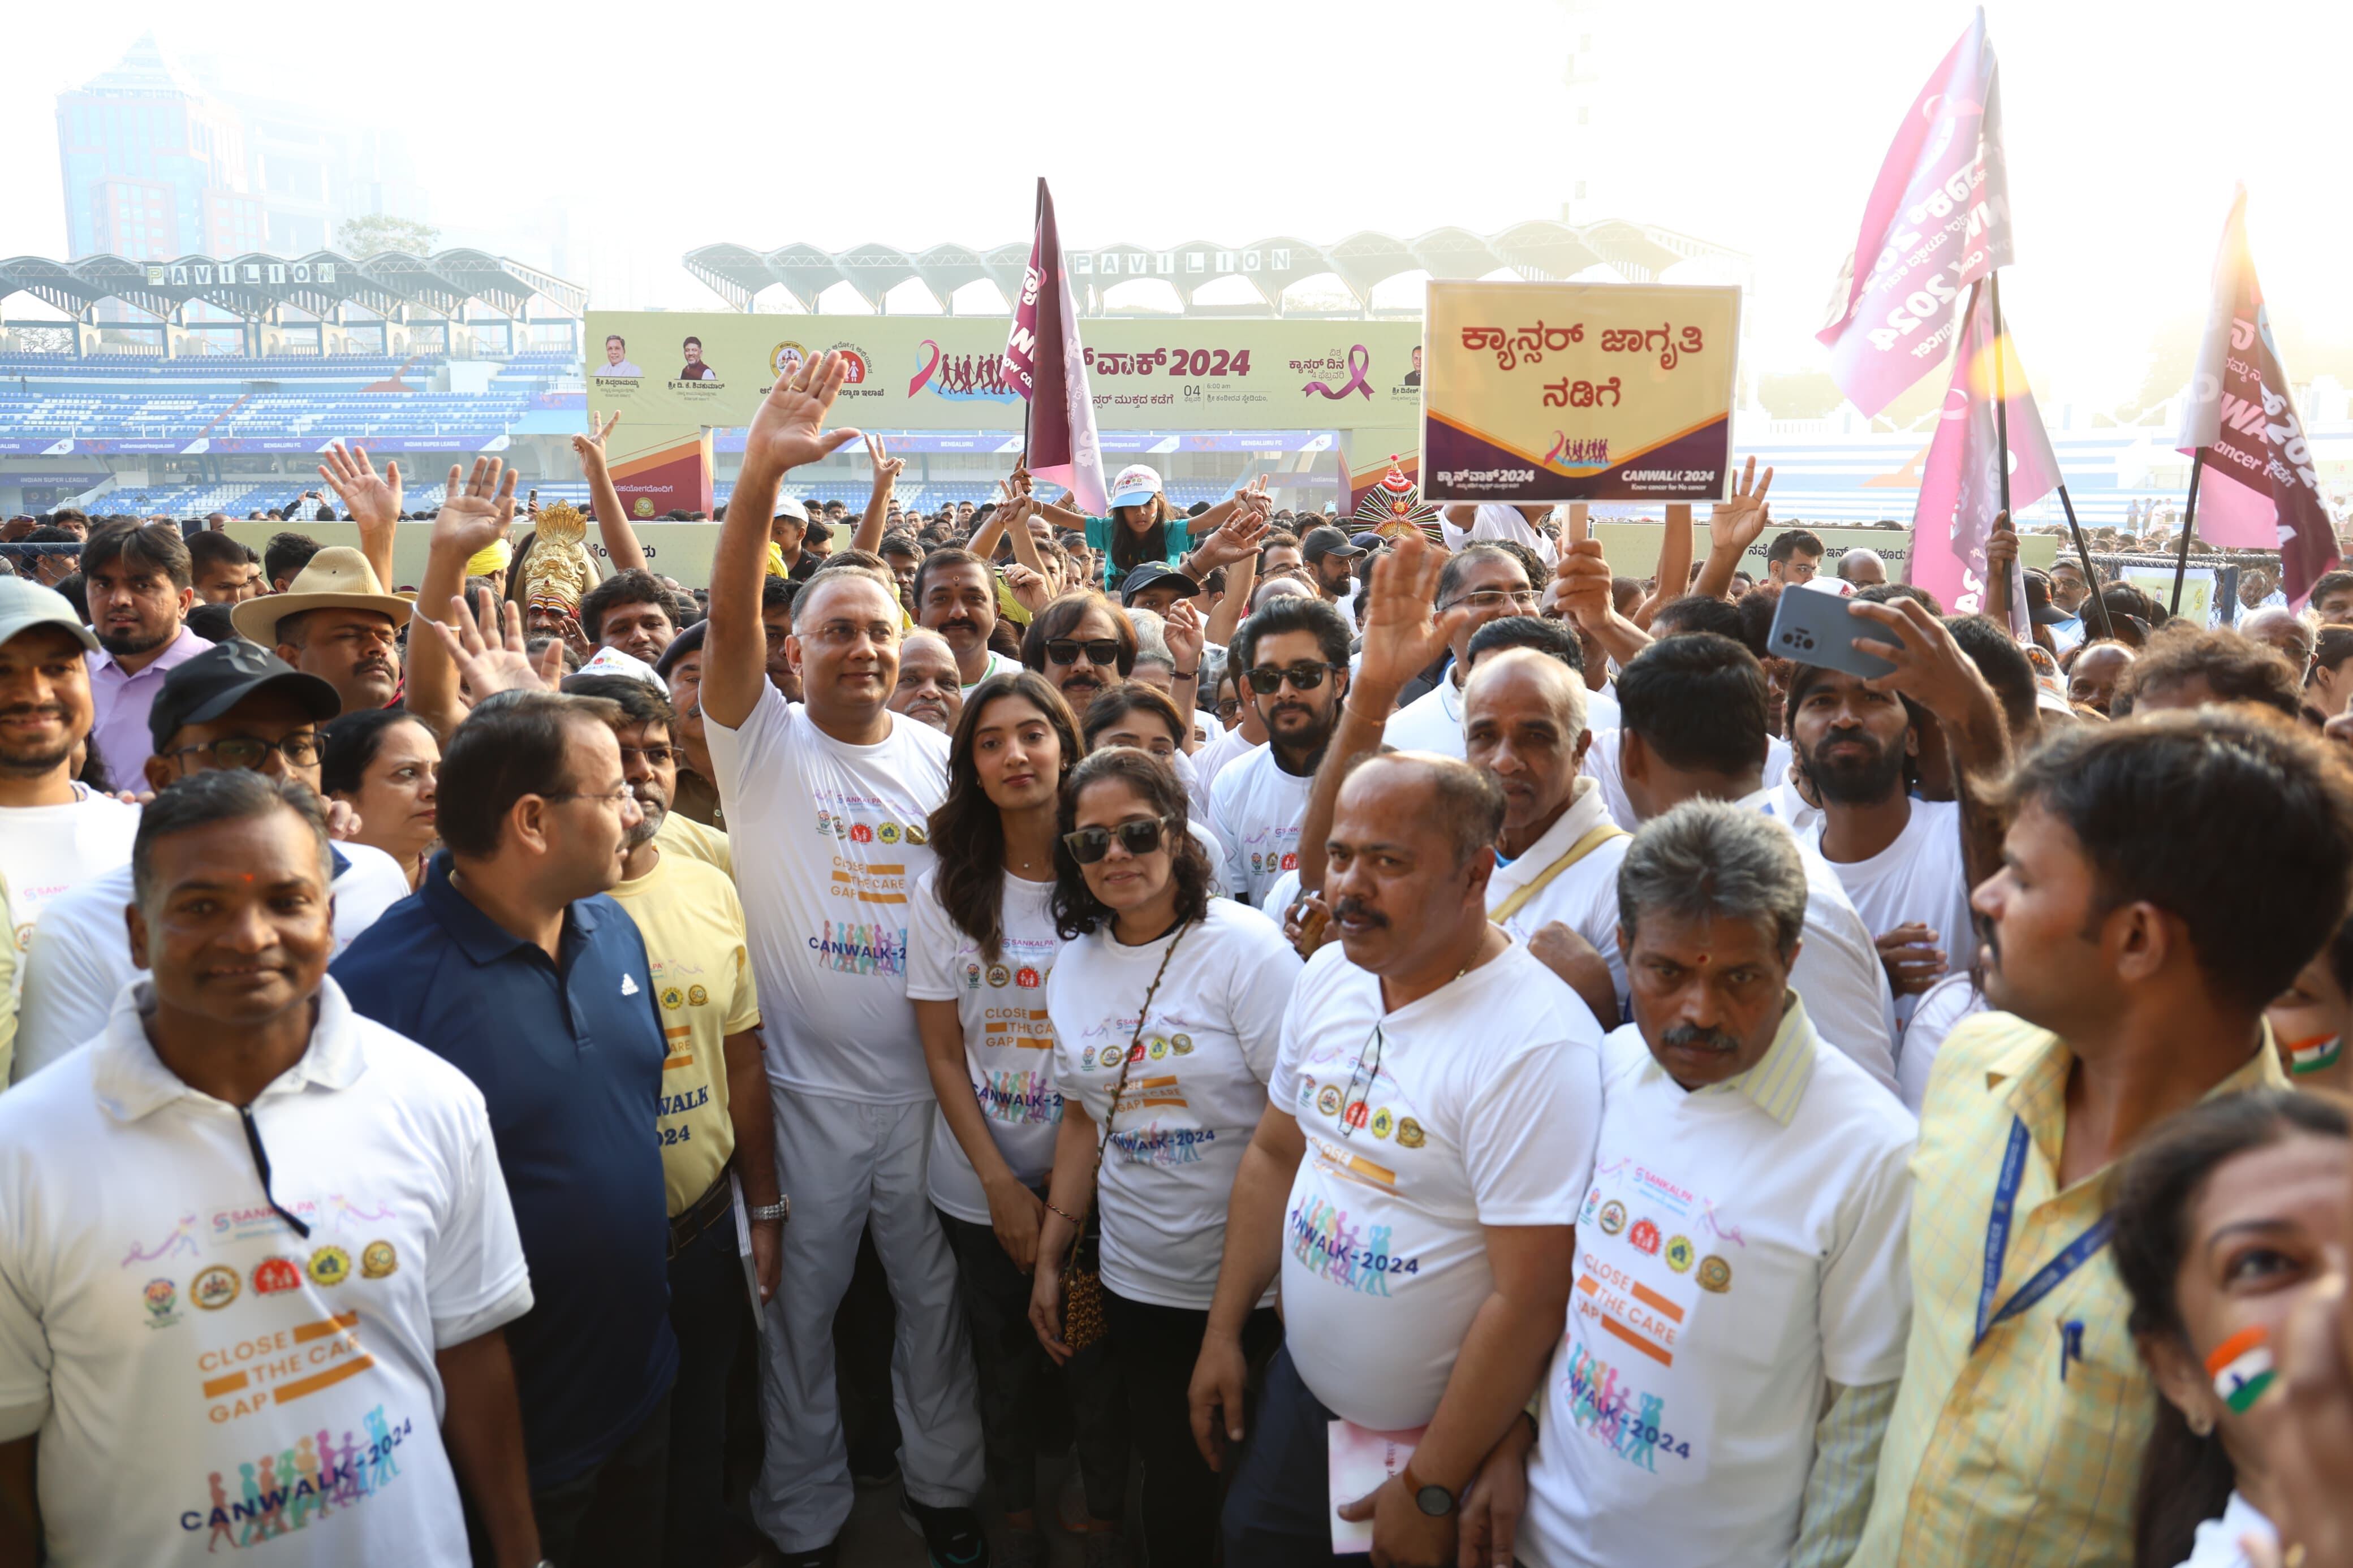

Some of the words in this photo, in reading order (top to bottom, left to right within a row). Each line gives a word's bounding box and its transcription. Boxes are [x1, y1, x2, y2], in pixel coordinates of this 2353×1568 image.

[1075, 250, 1289, 273] PAVILION
[149, 264, 334, 284] PAVILION
[1461, 319, 1584, 371] ಕ್ಯಾನ್ಸರ್
[1601, 321, 1704, 370] ಜಾಗೃತಿ
[1169, 349, 1251, 377] 2024
[1327, 358, 1345, 370] ದಿನ
[861, 388, 885, 397] ಇಲಾಖೆ
[1184, 385, 1201, 396] 04
[1542, 376, 1622, 408] ನಡಿಗೆ
[1115, 394, 1148, 409] ಮುಕ್ತದ
[1150, 394, 1174, 405] ಕಡೆಗೆ
[1499, 469, 1535, 482] 2024
[1683, 470, 1715, 482] 2024
[833, 856, 865, 874] CLOSE
[830, 885, 857, 899] GAP
[851, 876, 870, 888] THE
[873, 879, 905, 889] CARE
[808, 936, 906, 961] CANWALK-2
[1011, 939, 1054, 947] SANKALPA
[985, 1008, 1028, 1019] CLOSE
[1010, 1022, 1032, 1034] THE
[1035, 1023, 1053, 1035] CA
[985, 1036, 1015, 1048] GAP
[657, 1085, 709, 1117] WALK
[1644, 1170, 1693, 1203] SANKALPA
[1986, 1221, 2003, 1260] POLICE
[1583, 1252, 1631, 1291] CLOSE
[1598, 1287, 1628, 1317] THE
[1628, 1307, 1676, 1347] CARE
[198, 1331, 287, 1372] CLOSE
[247, 1355, 302, 1385] THE
[208, 1392, 270, 1424] GAP
[179, 1416, 413, 1532] CANWALK-2024
